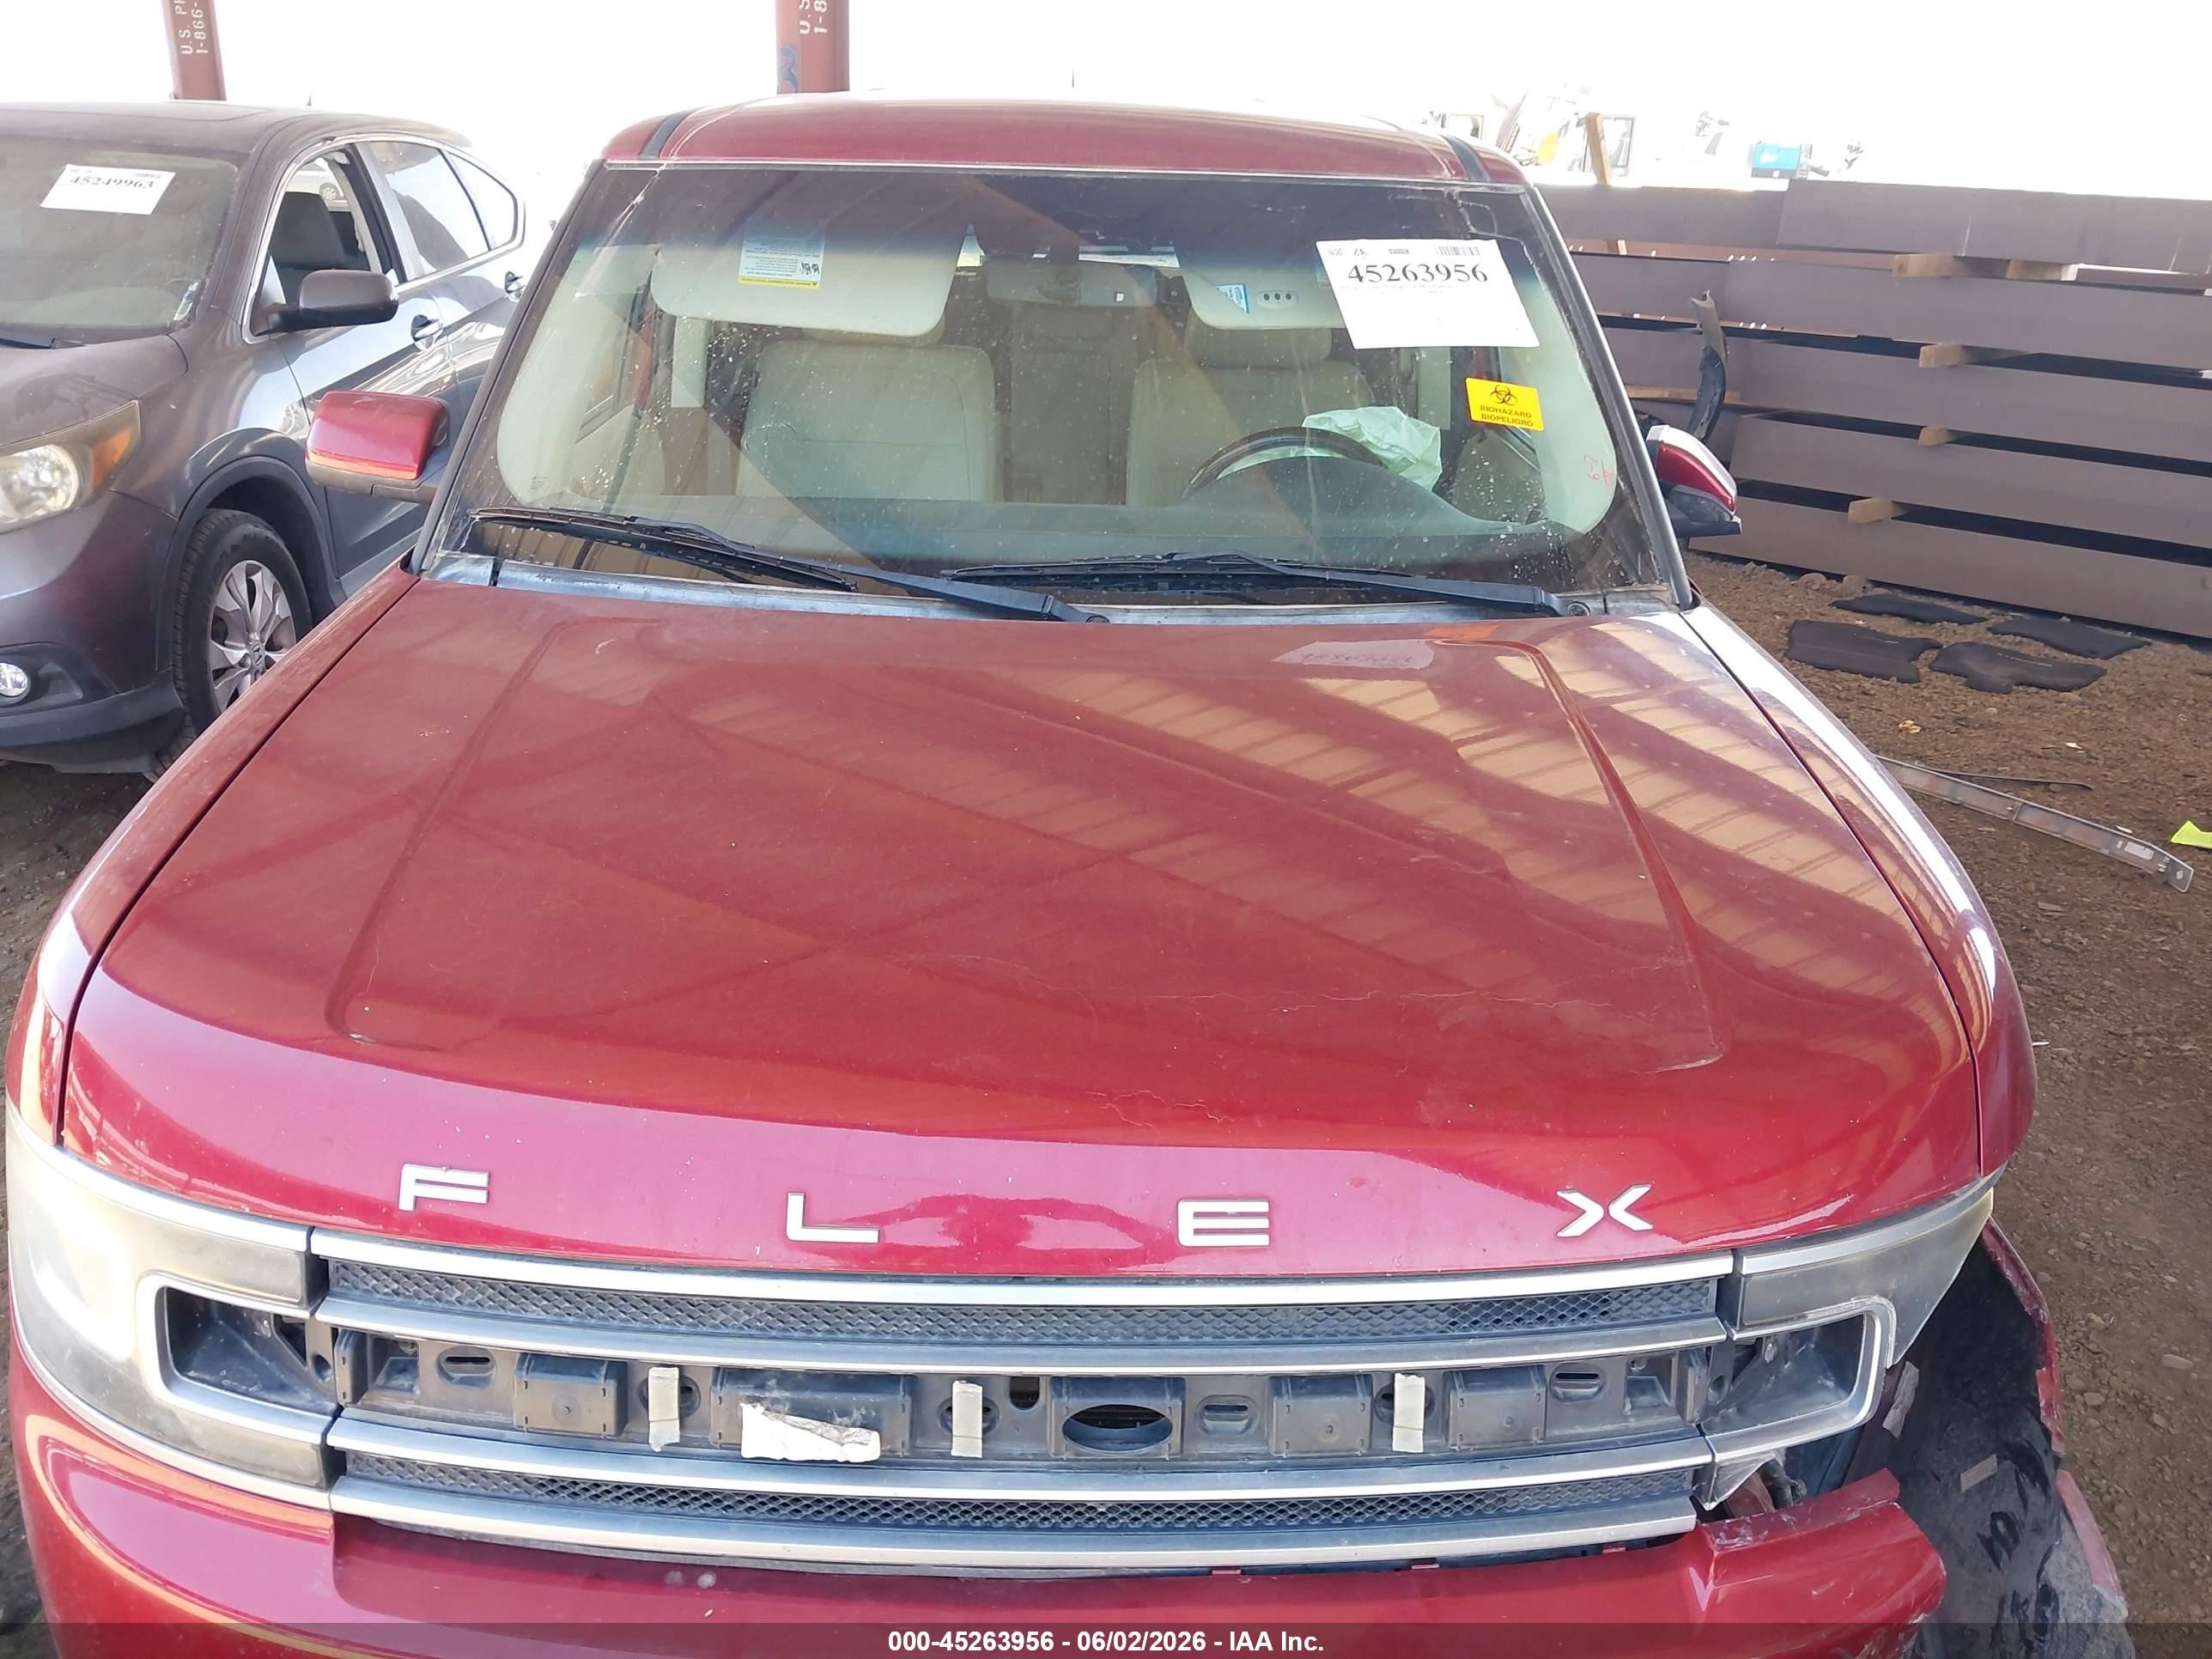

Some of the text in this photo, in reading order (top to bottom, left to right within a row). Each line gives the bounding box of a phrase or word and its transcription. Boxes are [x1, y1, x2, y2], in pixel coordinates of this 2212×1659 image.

[191, 1, 209, 54] 1-866-
[179, 24, 193, 55] U.S.
[1348, 263, 1488, 283] 45263956
[1480, 404, 1532, 419] BIOHAZARD
[1481, 413, 1534, 428] BIOPELIGRO
